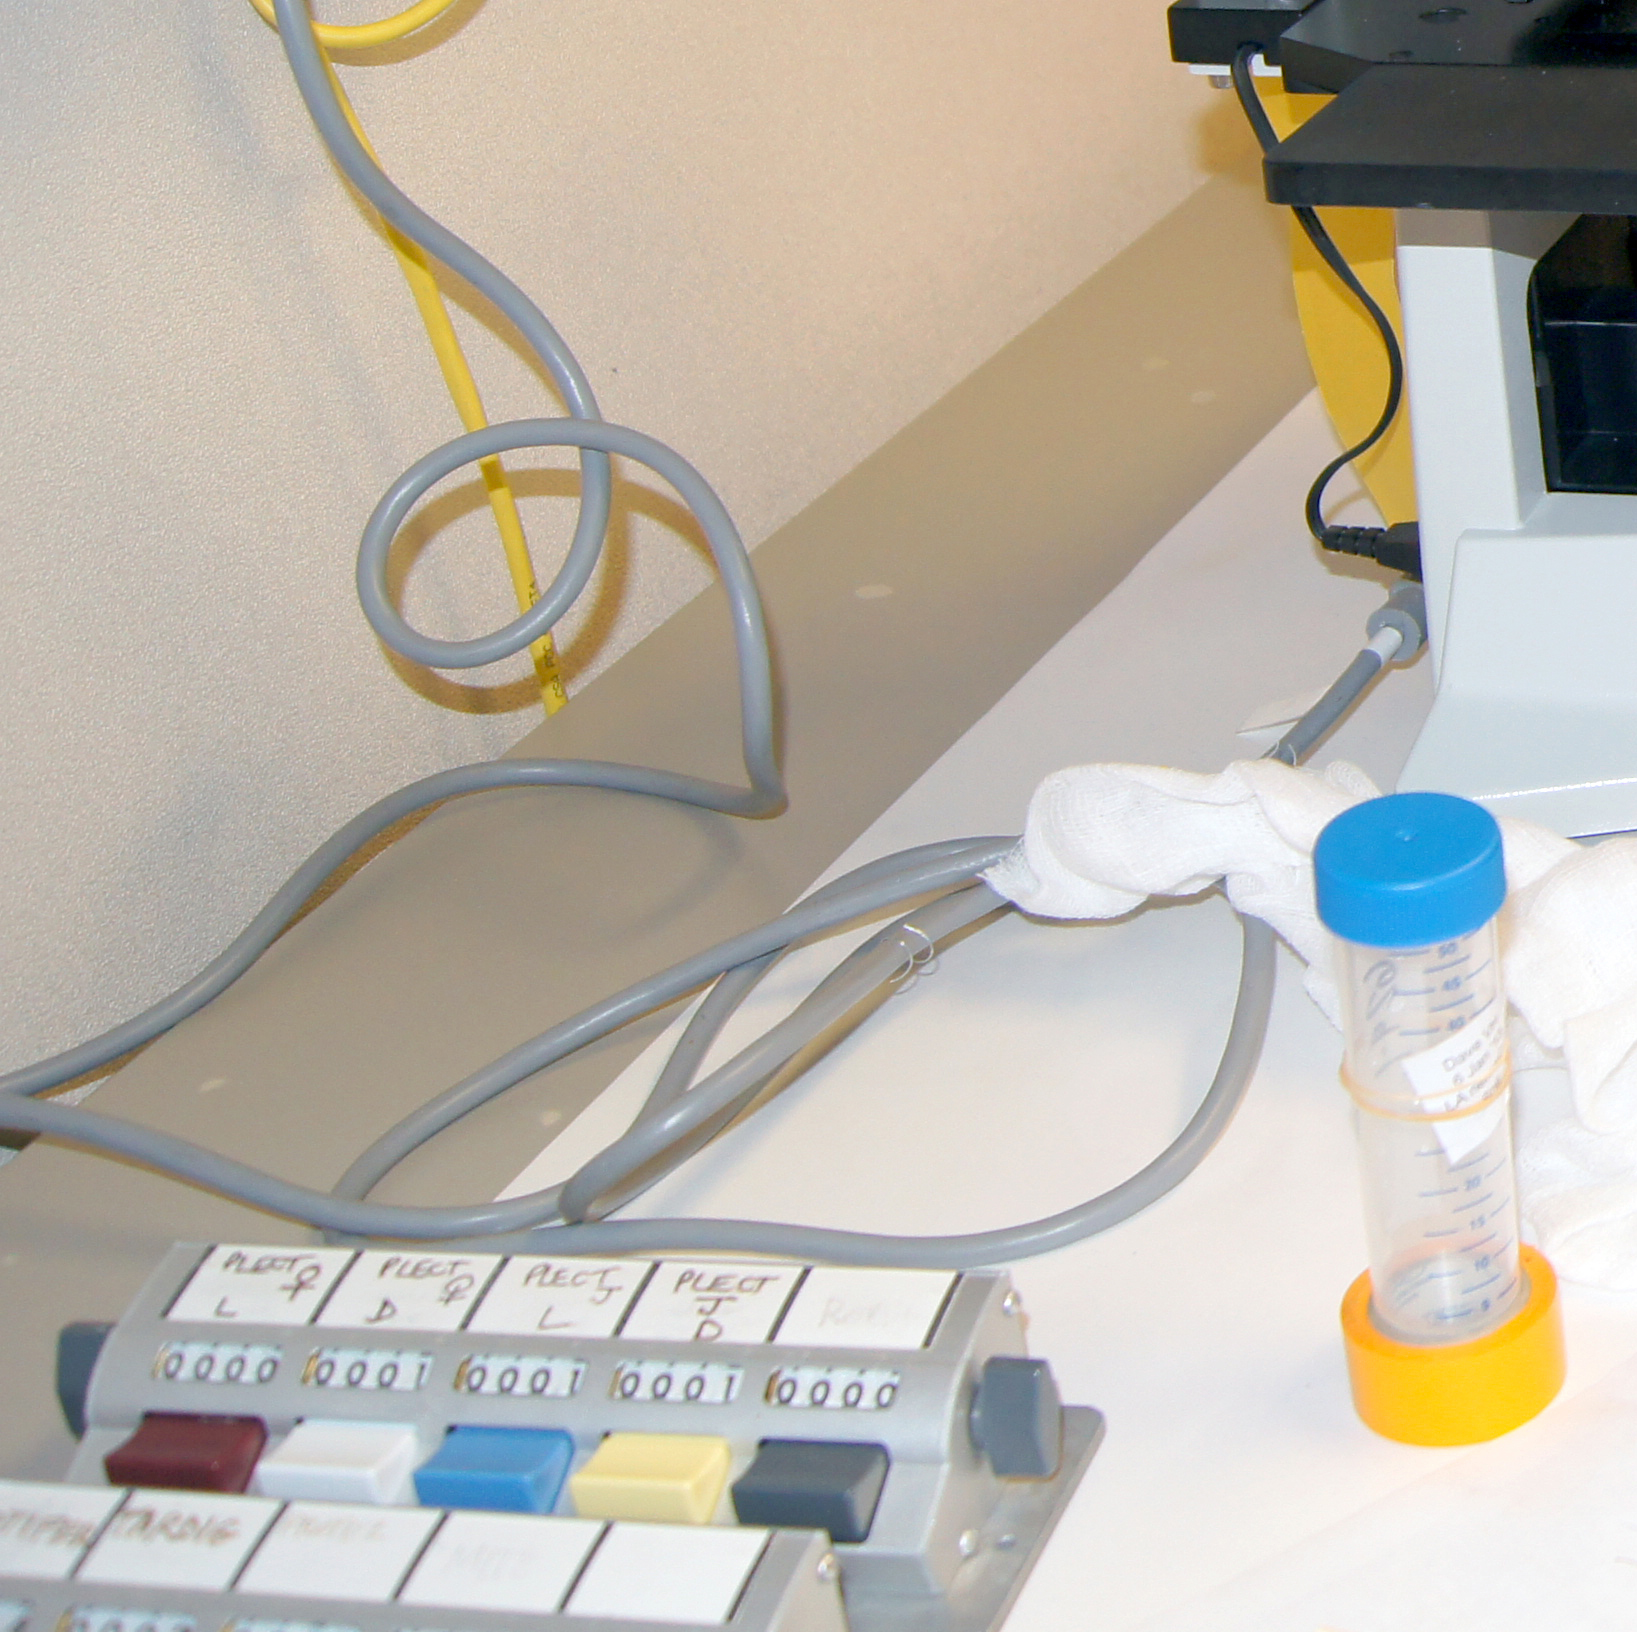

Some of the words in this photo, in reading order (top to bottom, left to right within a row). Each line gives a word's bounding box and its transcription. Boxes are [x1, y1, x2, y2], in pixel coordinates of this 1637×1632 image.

[223, 1252, 310, 1275] PLECT
[379, 1257, 471, 1280] PLECT
[524, 1264, 618, 1289] PLECT
[673, 1269, 781, 1294] PLECT
[215, 1297, 240, 1319] L
[366, 1299, 398, 1323] D
[538, 1307, 570, 1330] L
[694, 1319, 723, 1342] D
[164, 1348, 278, 1384] 0000
[315, 1357, 426, 1390] 0001
[468, 1361, 583, 1394] 0001
[620, 1370, 737, 1402] 0001
[779, 1377, 898, 1408] 0000
